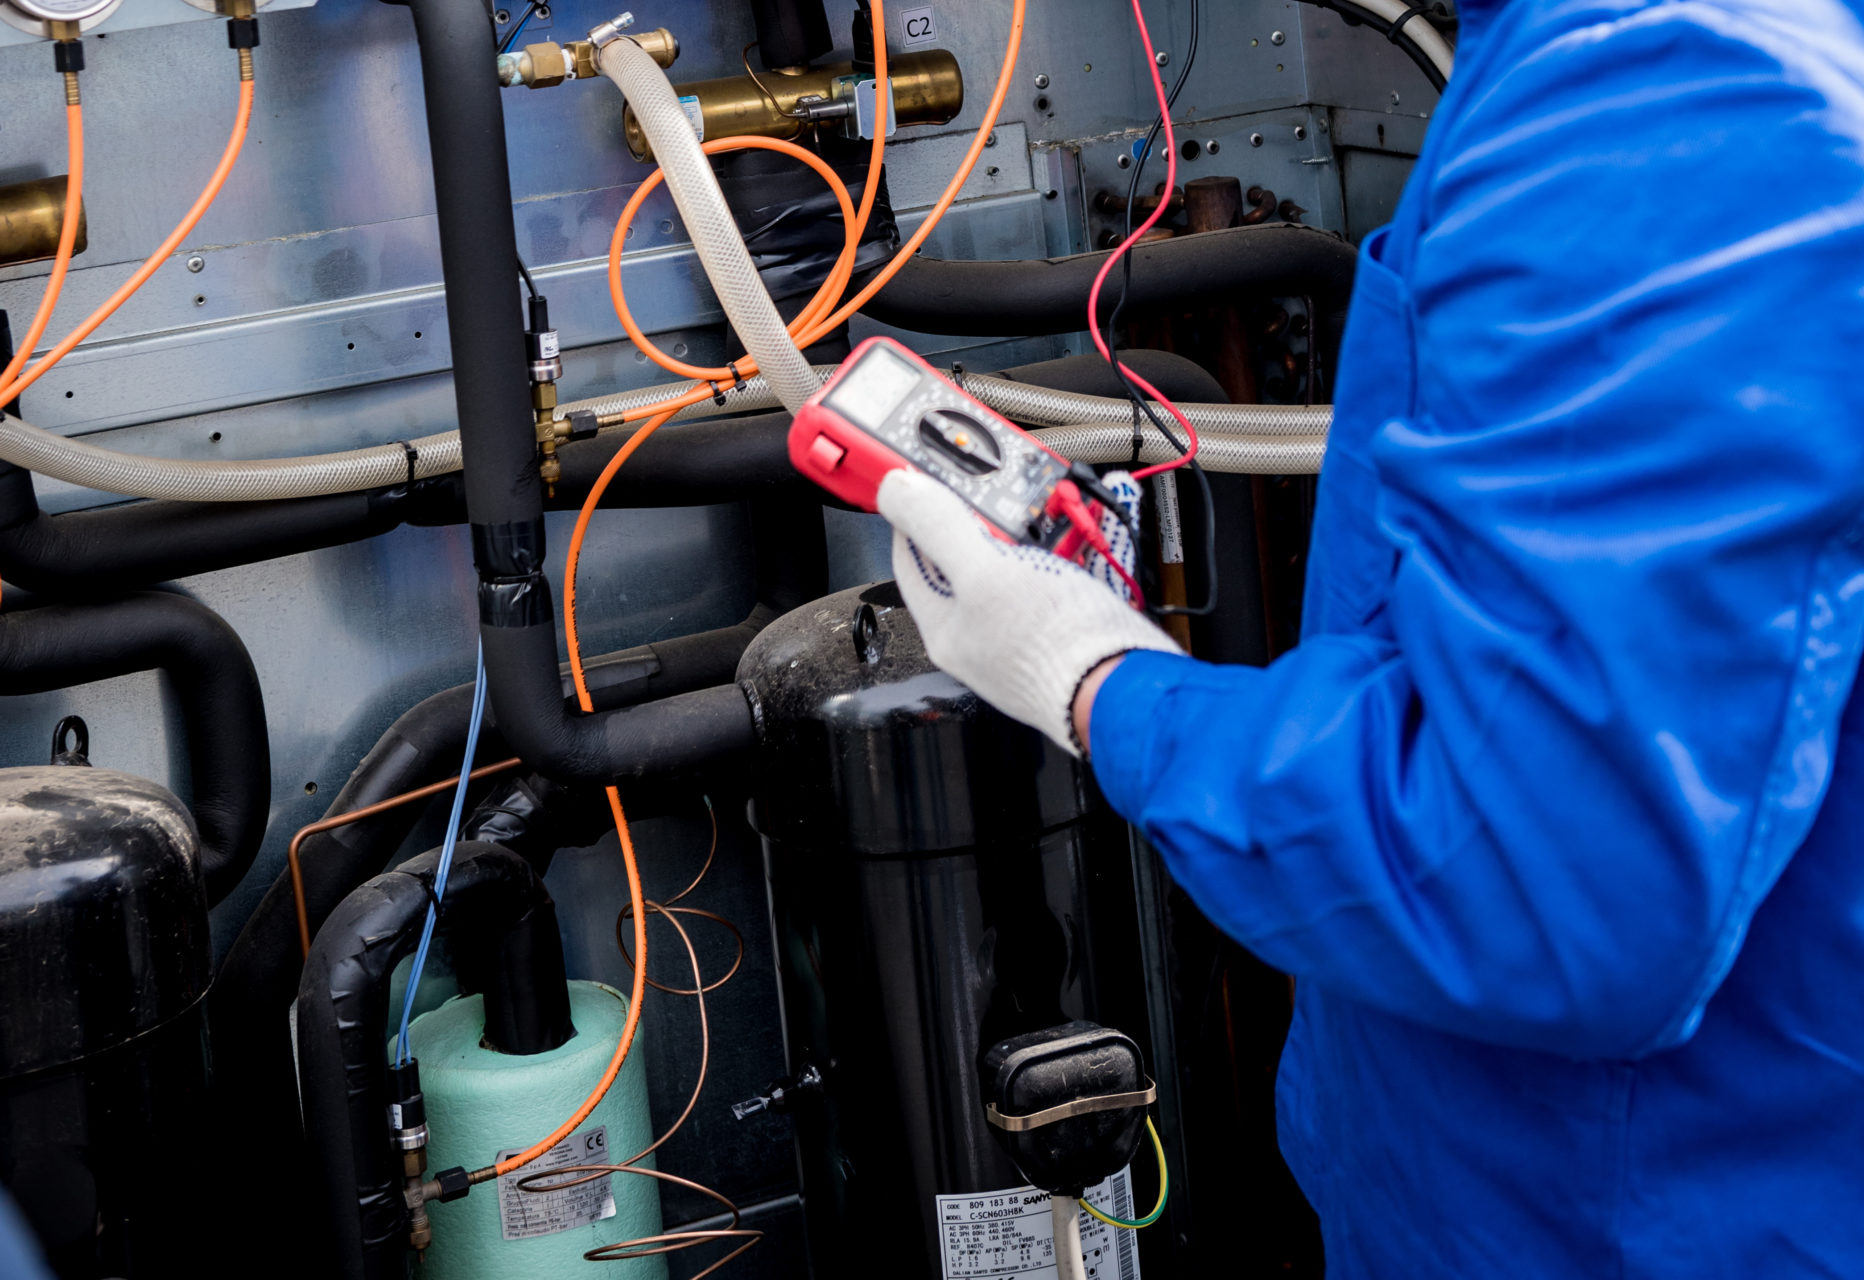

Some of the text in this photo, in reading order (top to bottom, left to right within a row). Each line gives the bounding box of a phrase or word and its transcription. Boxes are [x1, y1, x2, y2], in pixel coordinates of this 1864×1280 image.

[906, 16, 932, 37] C2
[587, 1133, 603, 1150] CE
[970, 1207, 1024, 1220] C-SCN603H8K
[1090, 1227, 1105, 1237] WIRING
